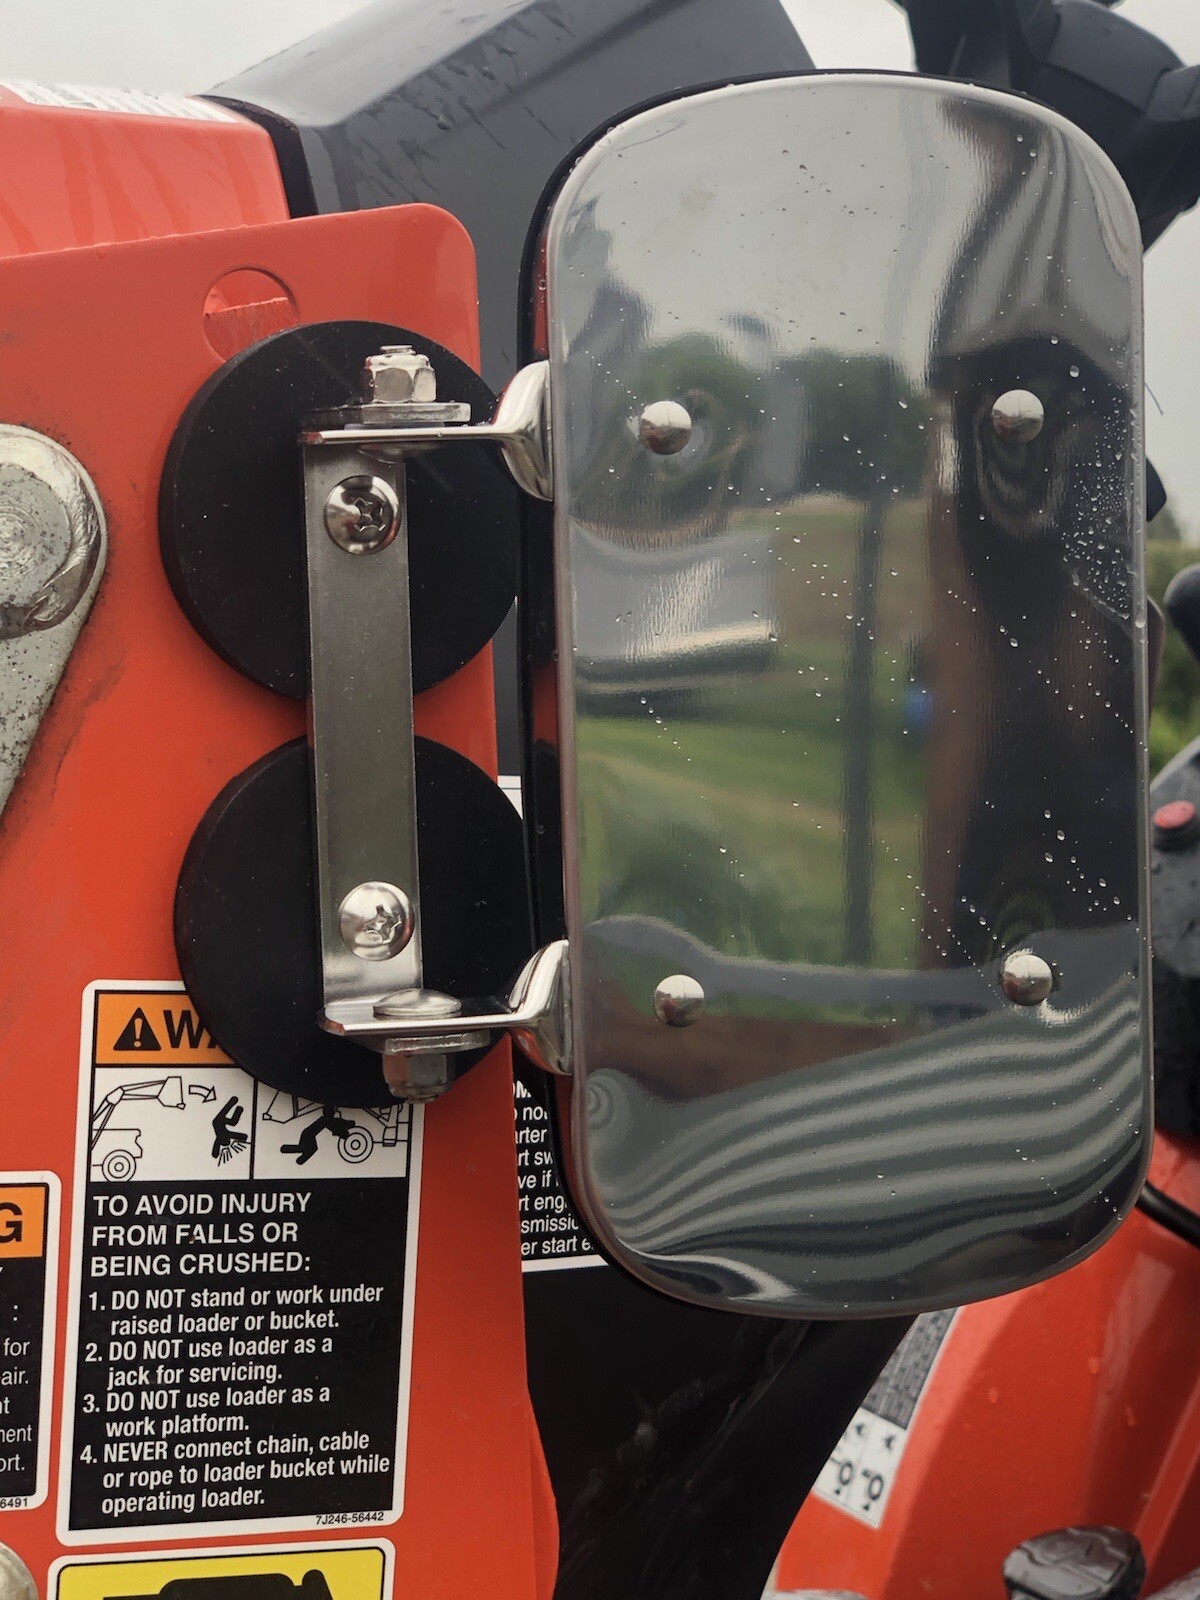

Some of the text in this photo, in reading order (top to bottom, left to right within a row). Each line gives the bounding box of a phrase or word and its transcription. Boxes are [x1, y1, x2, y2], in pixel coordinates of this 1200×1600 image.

[542, 1169, 552, 1187] if
[93, 1193, 311, 1216] TO AVOID INJURY
[92, 1222, 297, 1246] FROM FALLS OR
[542, 1235, 577, 1254] start
[91, 1252, 310, 1277] BEING CRUSHED:
[89, 1284, 383, 1310] 1. DO NOT stand or work under
[111, 1310, 338, 1335] raised loader or bucket.
[3, 1337, 31, 1356] for
[85, 1336, 332, 1362] 2. DO NOT use loader as a
[107, 1361, 282, 1390] jack for servicing.
[83, 1386, 329, 1413] 3. DO NOT use loader as a
[106, 1413, 248, 1438] work platform.
[80, 1431, 369, 1463] 4. NEVER connect chain, cable
[103, 1454, 389, 1491] or rope to loader bucket while
[102, 1487, 264, 1517] operating loader.
[316, 1511, 384, 1525] 7J246-56442
